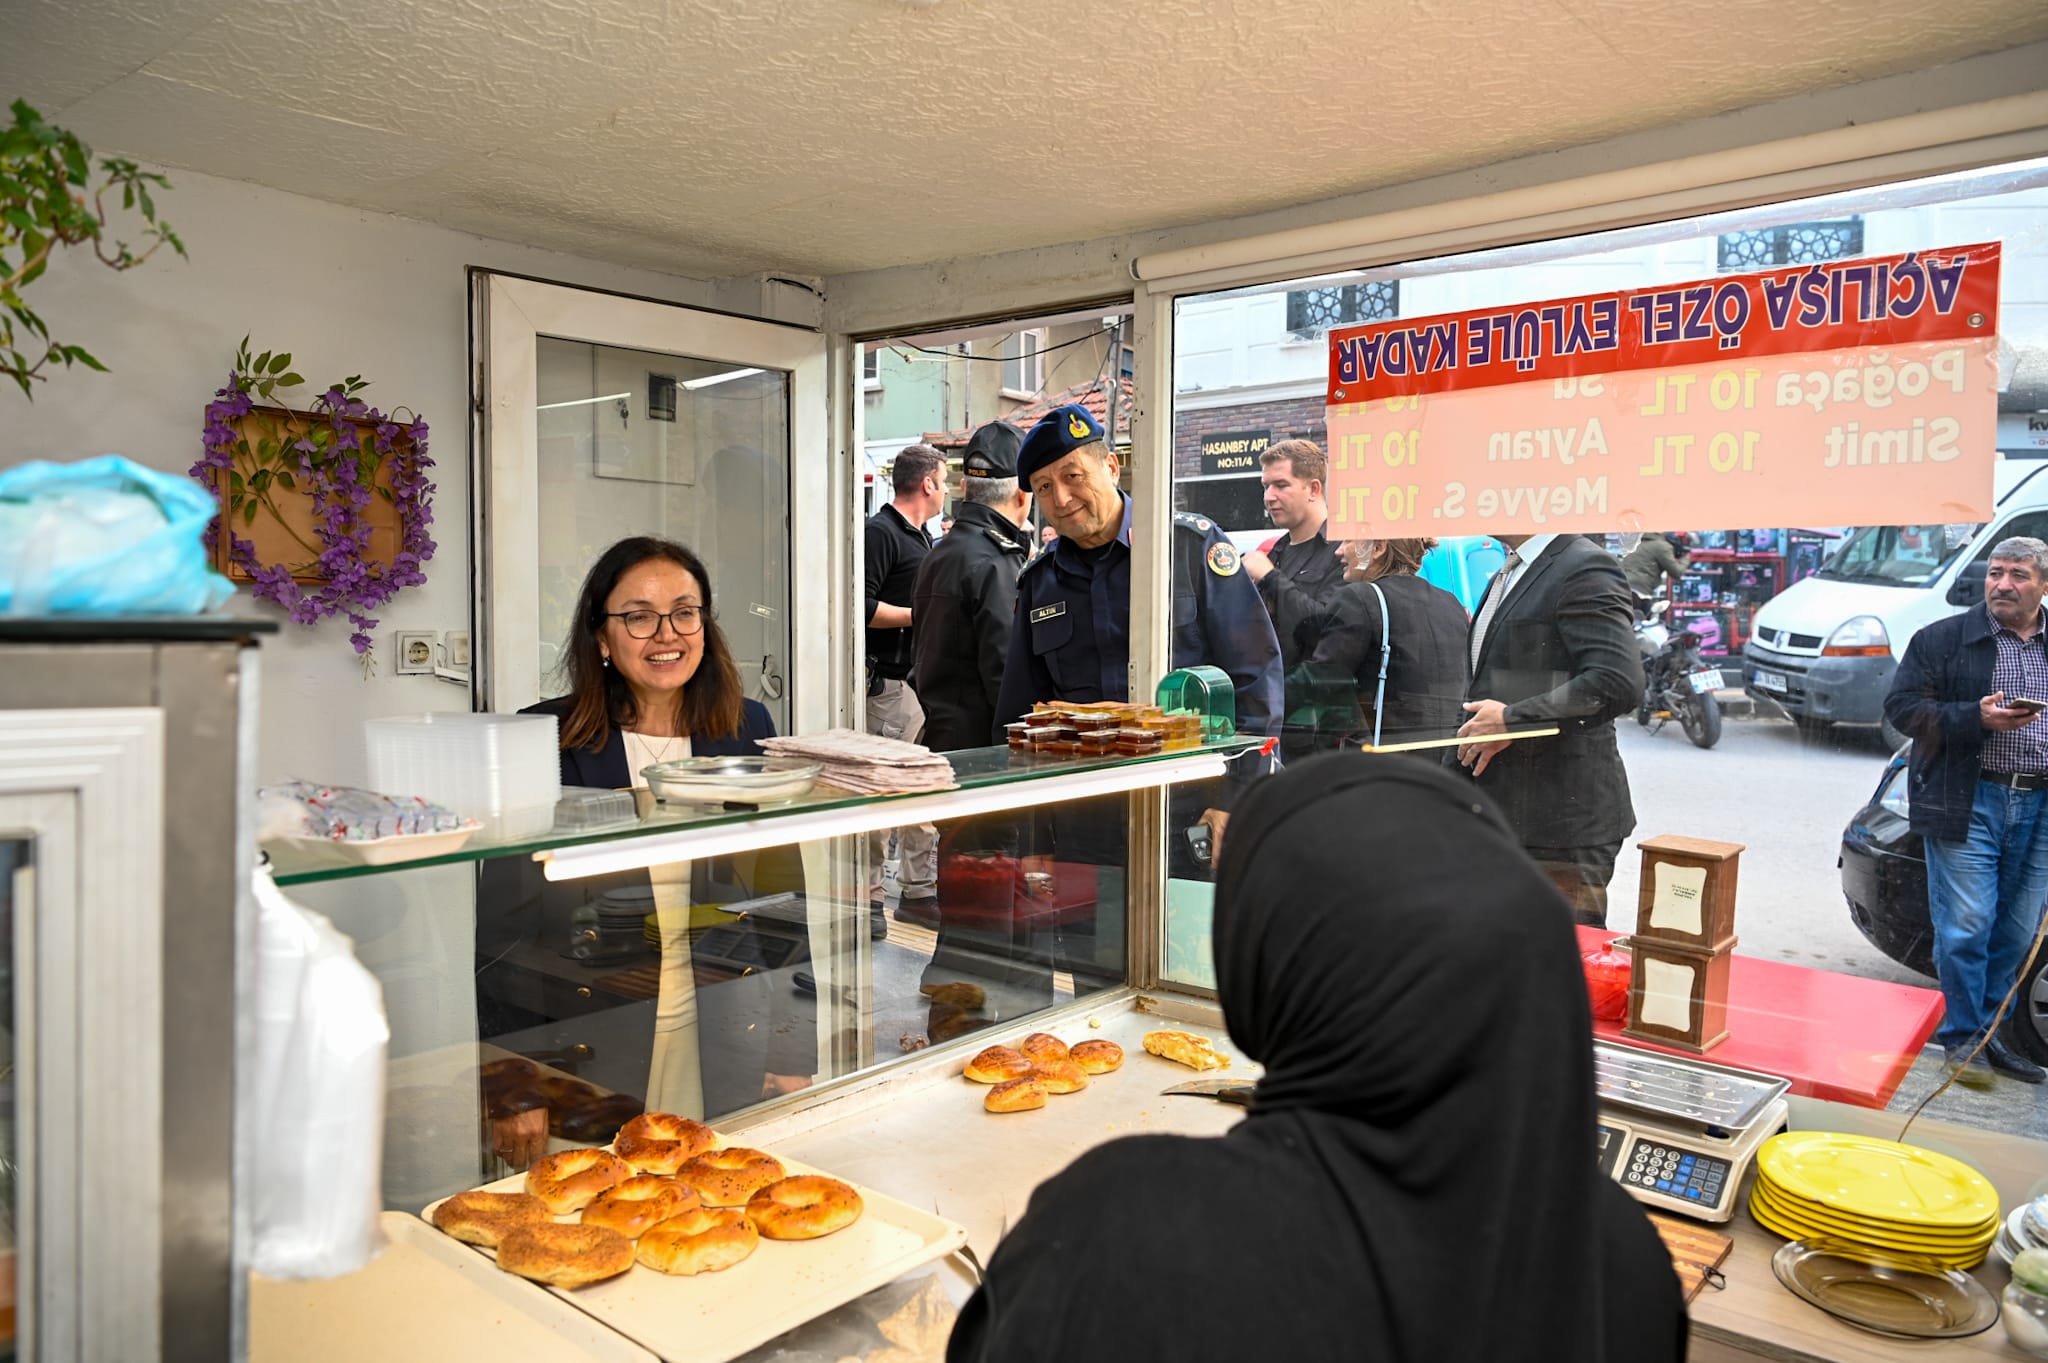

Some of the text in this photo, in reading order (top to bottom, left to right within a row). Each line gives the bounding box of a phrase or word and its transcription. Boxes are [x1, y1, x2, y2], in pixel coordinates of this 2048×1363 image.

[1338, 252, 1969, 383] AÇILIŞA ÖZEL EYLÜLE KADAR
[1202, 440, 1250, 456] HASANBEY
[1217, 456, 1253, 468] NO:11/4
